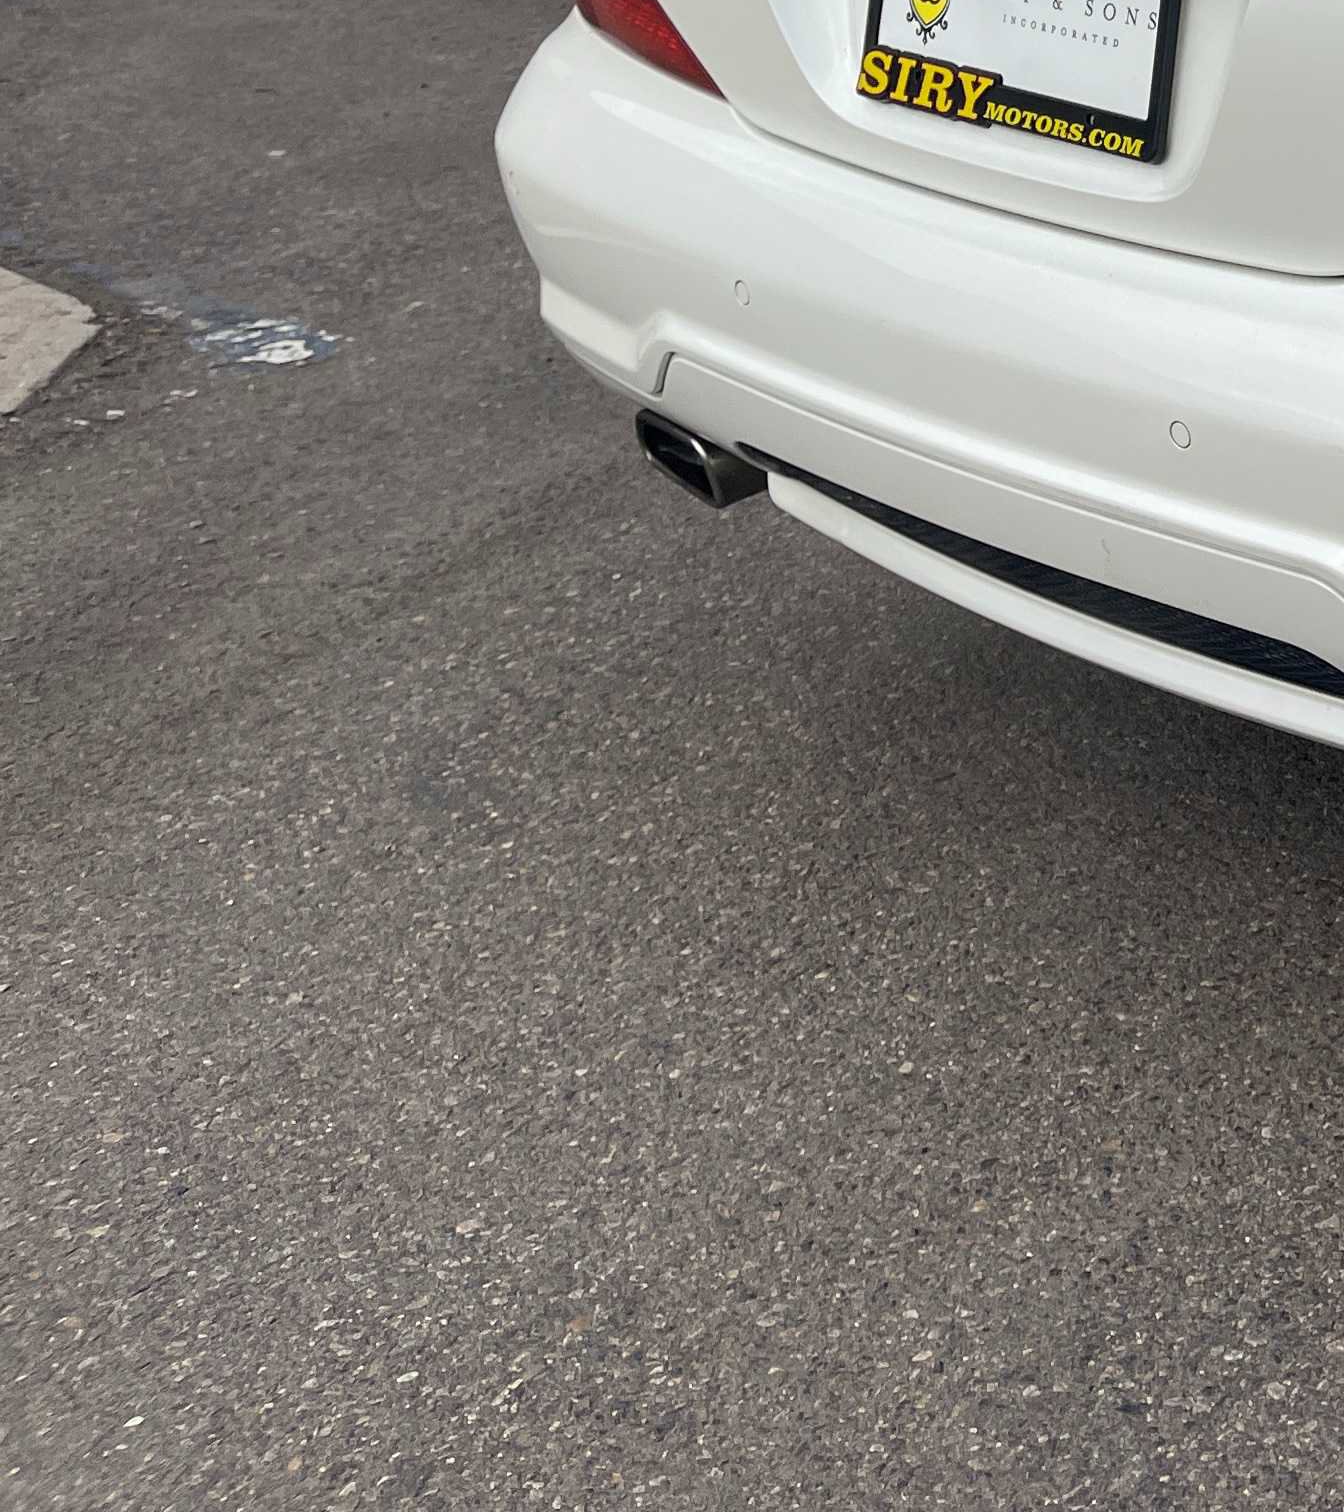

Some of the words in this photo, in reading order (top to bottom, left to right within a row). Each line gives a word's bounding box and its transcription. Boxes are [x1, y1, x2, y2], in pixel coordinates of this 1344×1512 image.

[1002, 14, 1120, 48] INCORPORATED
[859, 49, 994, 120] SIRY
[983, 101, 1145, 158] MOTORS.COM
